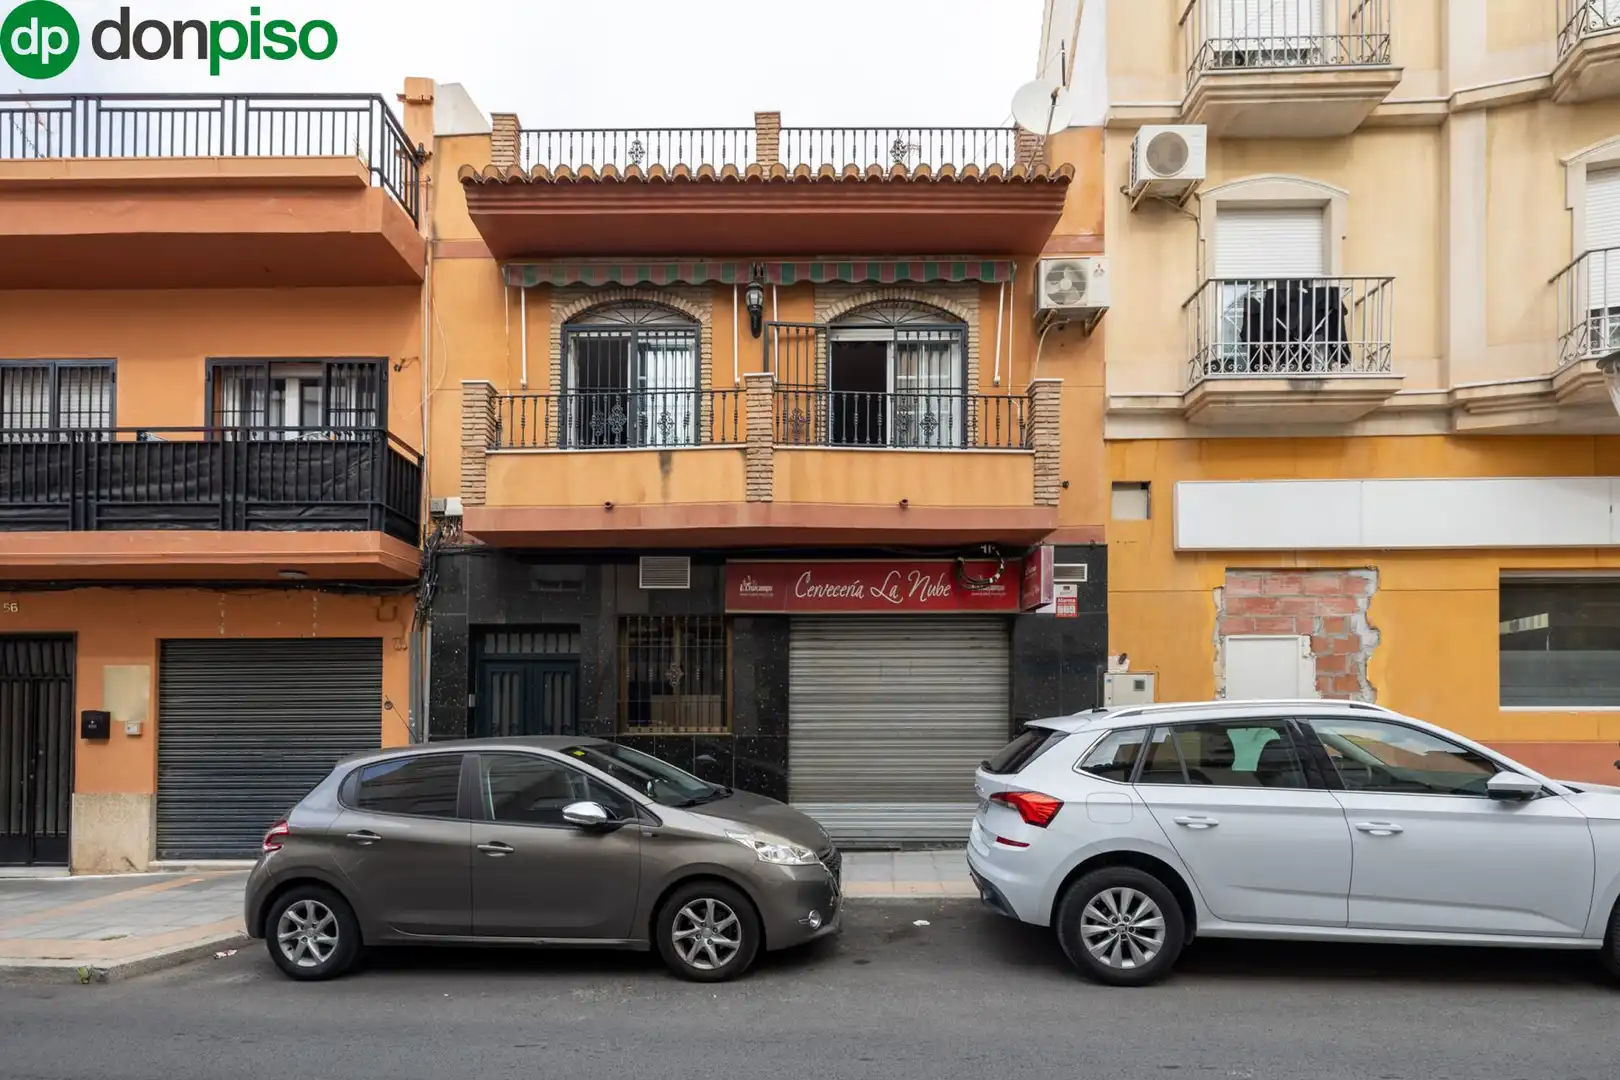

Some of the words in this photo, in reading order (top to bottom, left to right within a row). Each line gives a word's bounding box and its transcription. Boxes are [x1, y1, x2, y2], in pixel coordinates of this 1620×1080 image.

[795, 570, 865, 598] Cervecería
[870, 570, 904, 603] La
[907, 570, 951, 602] Nube
[3, 602, 19, 613] 56
